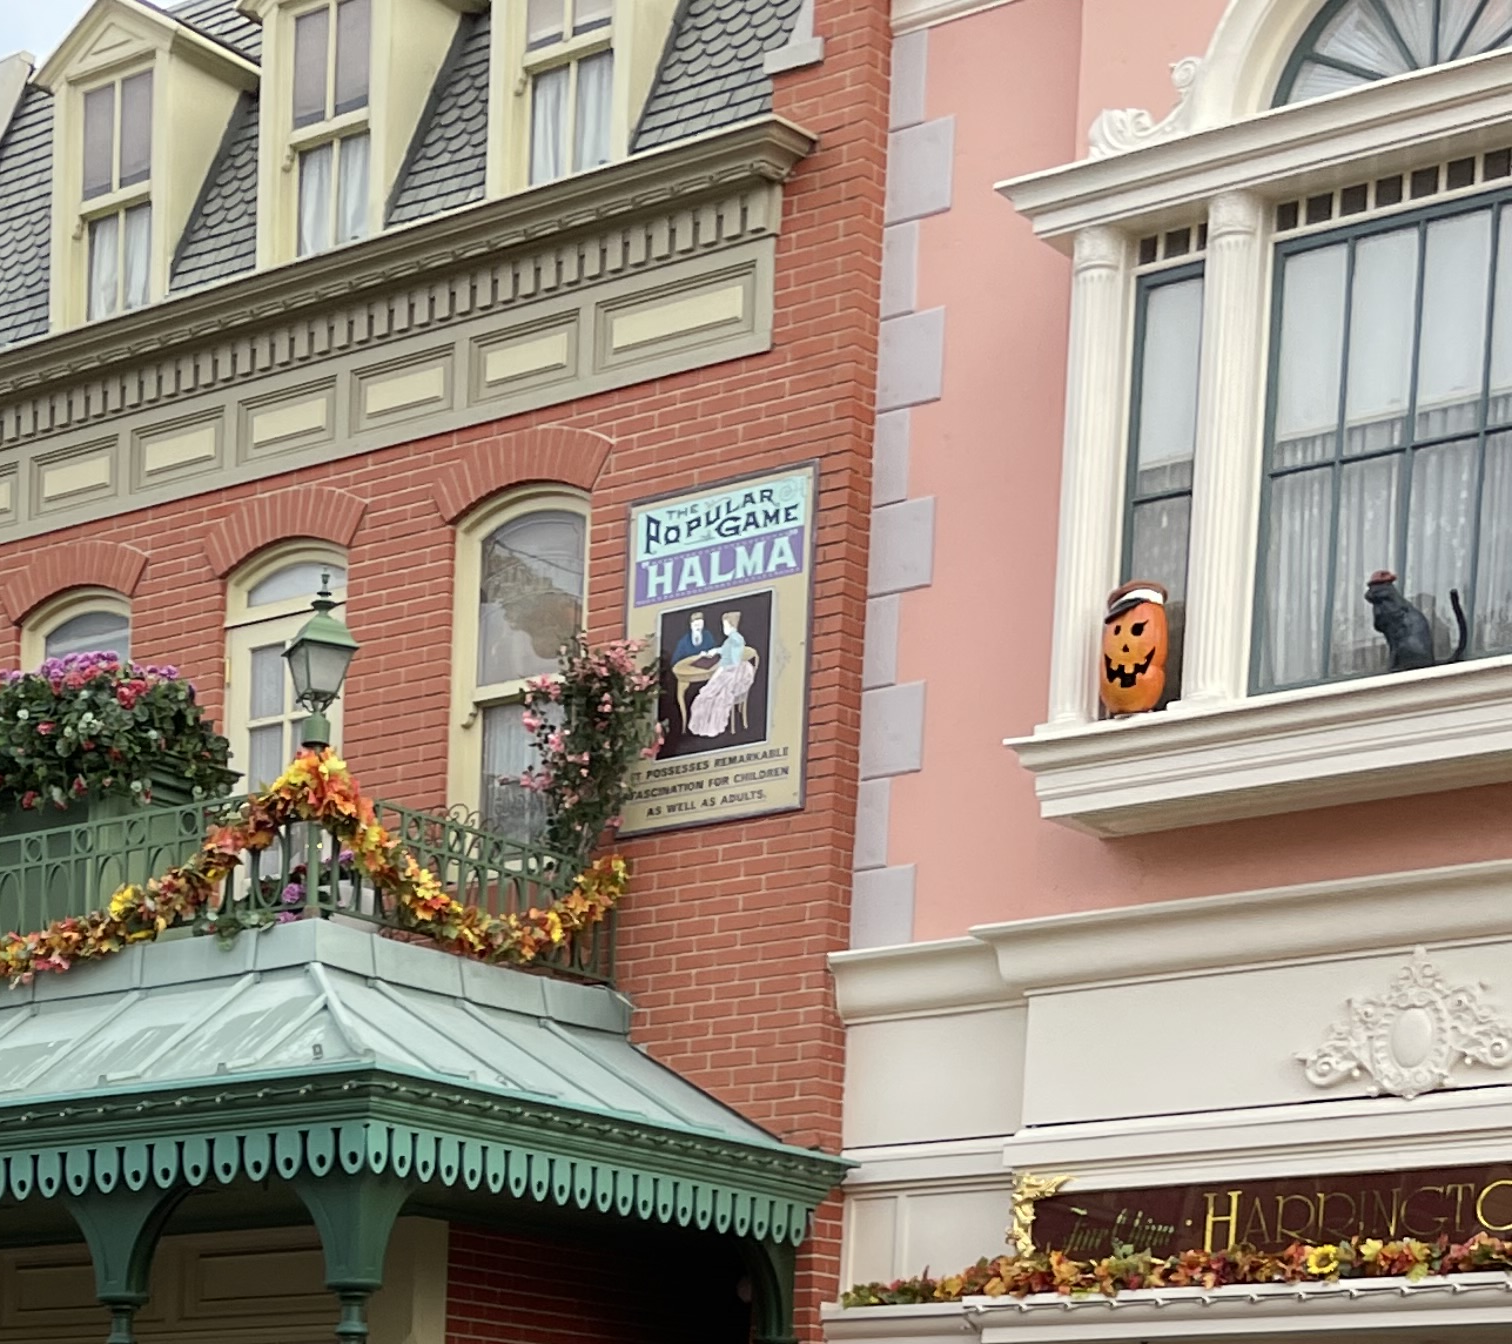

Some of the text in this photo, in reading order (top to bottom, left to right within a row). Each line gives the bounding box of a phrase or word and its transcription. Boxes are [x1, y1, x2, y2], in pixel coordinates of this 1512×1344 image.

[645, 488, 774, 554] POPULAR
[666, 503, 699, 520] THE
[715, 503, 800, 538] GAME
[646, 536, 797, 598] HALMA
[646, 760, 710, 780] POSSESSES
[714, 747, 789, 767] REMARKABLE
[708, 774, 729, 788] FOR
[733, 766, 789, 784] CHILDREN
[646, 805, 662, 818] AS
[666, 800, 696, 814] WELL
[700, 796, 715, 808] AS
